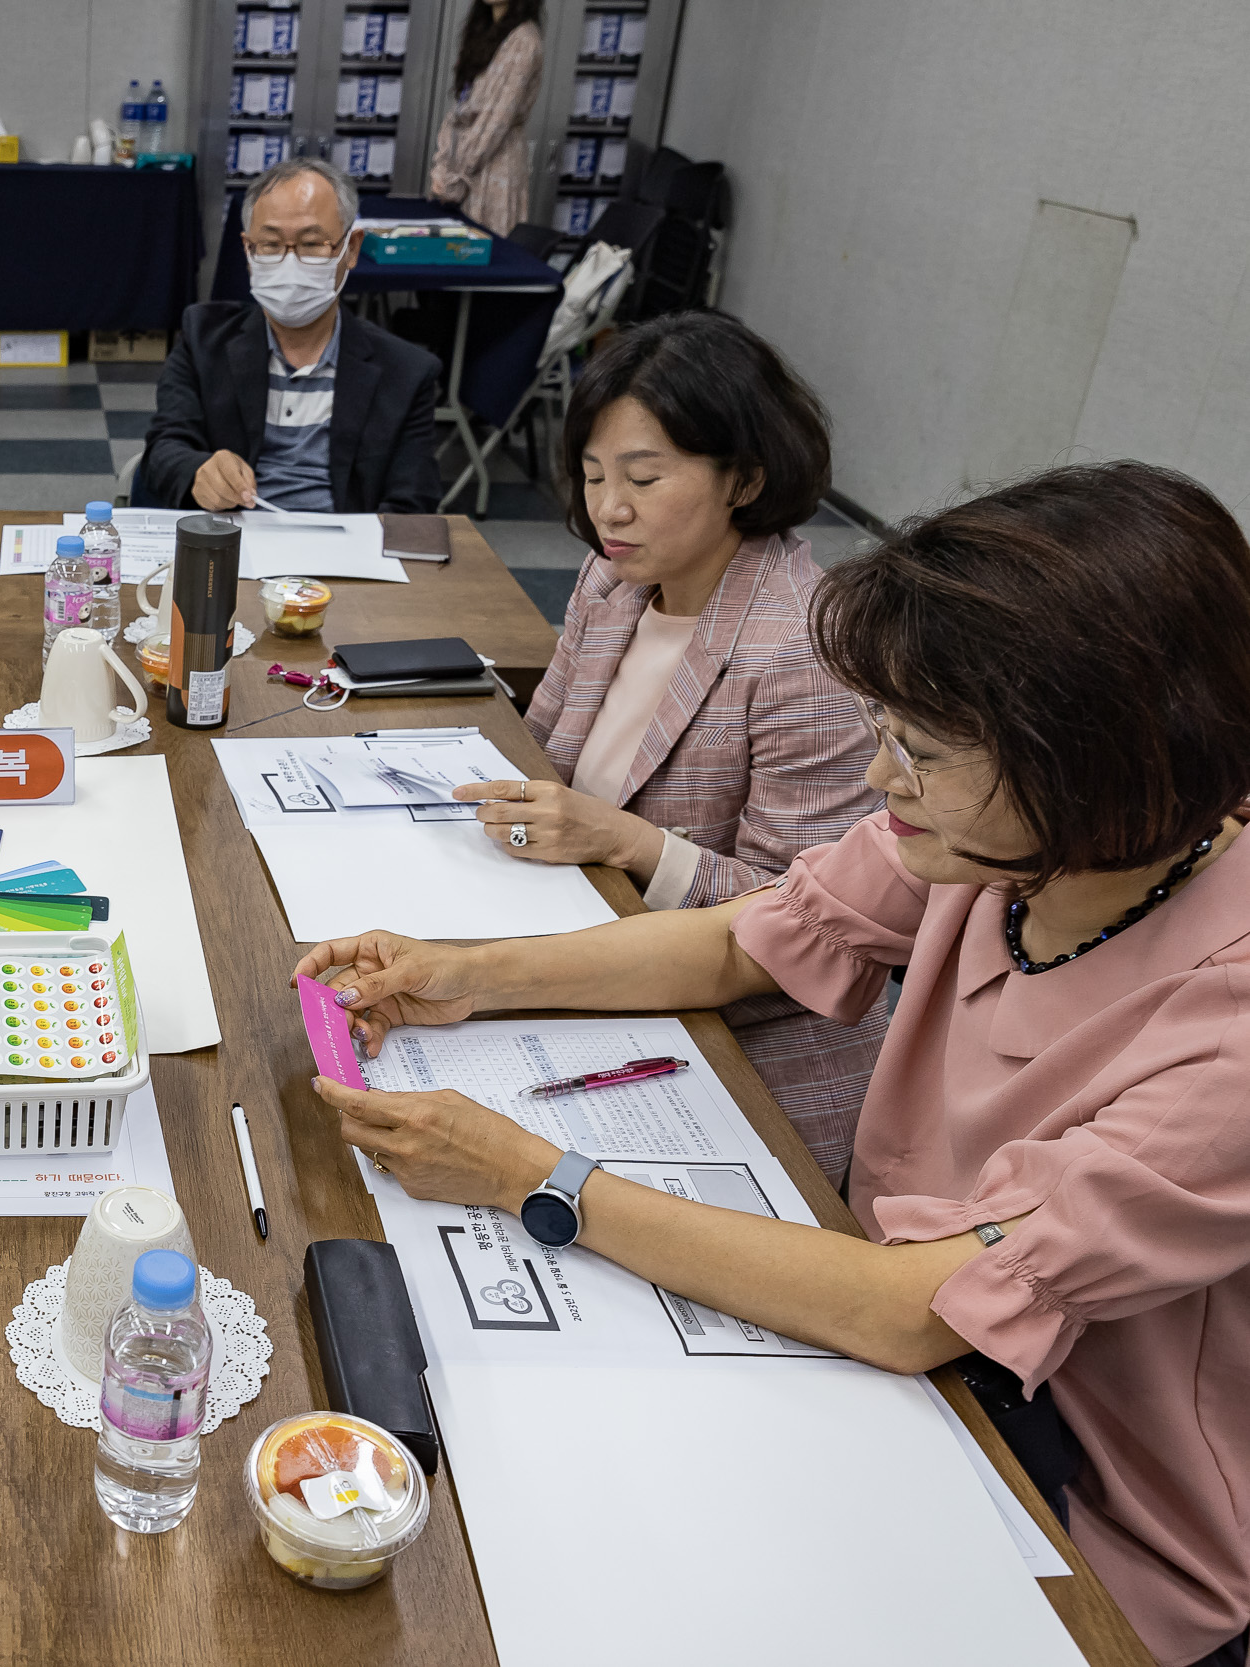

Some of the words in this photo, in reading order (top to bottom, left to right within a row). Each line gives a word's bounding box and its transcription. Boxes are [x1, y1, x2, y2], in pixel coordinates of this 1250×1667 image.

[35, 1173, 61, 1182] 하기
[68, 1173, 125, 1184] 때문이다.
[470, 1223, 493, 1250] 평등한
[491, 1222, 509, 1243] 권리와
[500, 1244, 519, 1272] 피해자의
[564, 1299, 582, 1322] 2023년
[674, 1299, 693, 1325] Question
